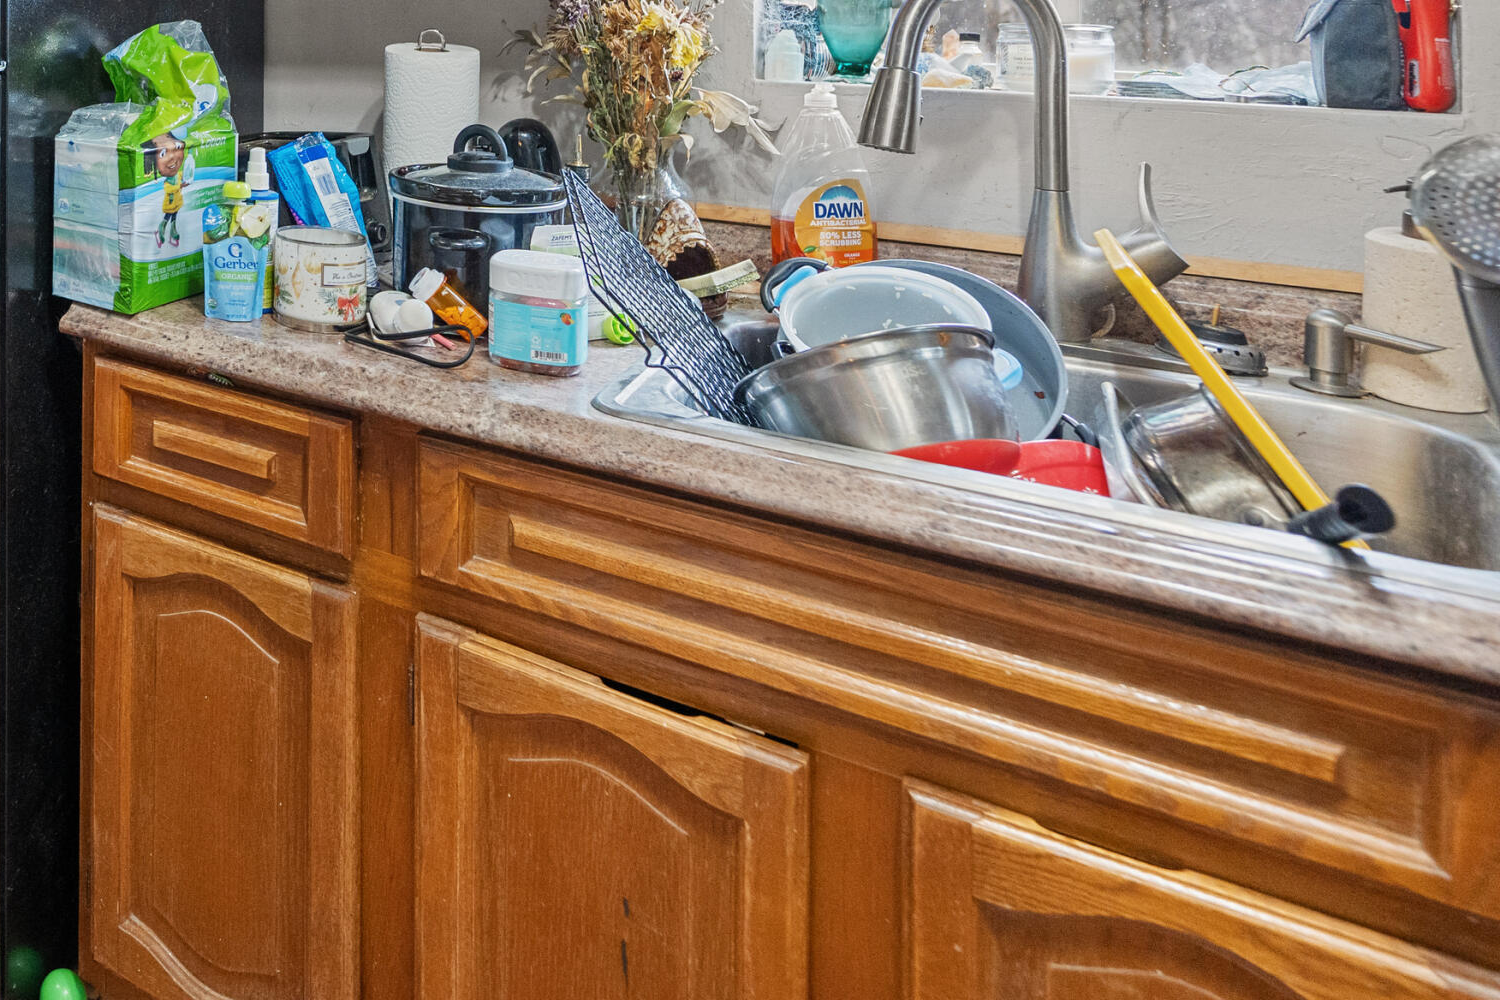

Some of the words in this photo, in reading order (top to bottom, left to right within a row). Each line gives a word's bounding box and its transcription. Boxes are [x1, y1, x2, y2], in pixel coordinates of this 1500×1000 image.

[814, 202, 863, 219] DAWN
[809, 219, 866, 227] ANTIBACTERIAL
[820, 231, 840, 239] 50%
[842, 231, 861, 239] LESS
[214, 256, 259, 270] Gerber
